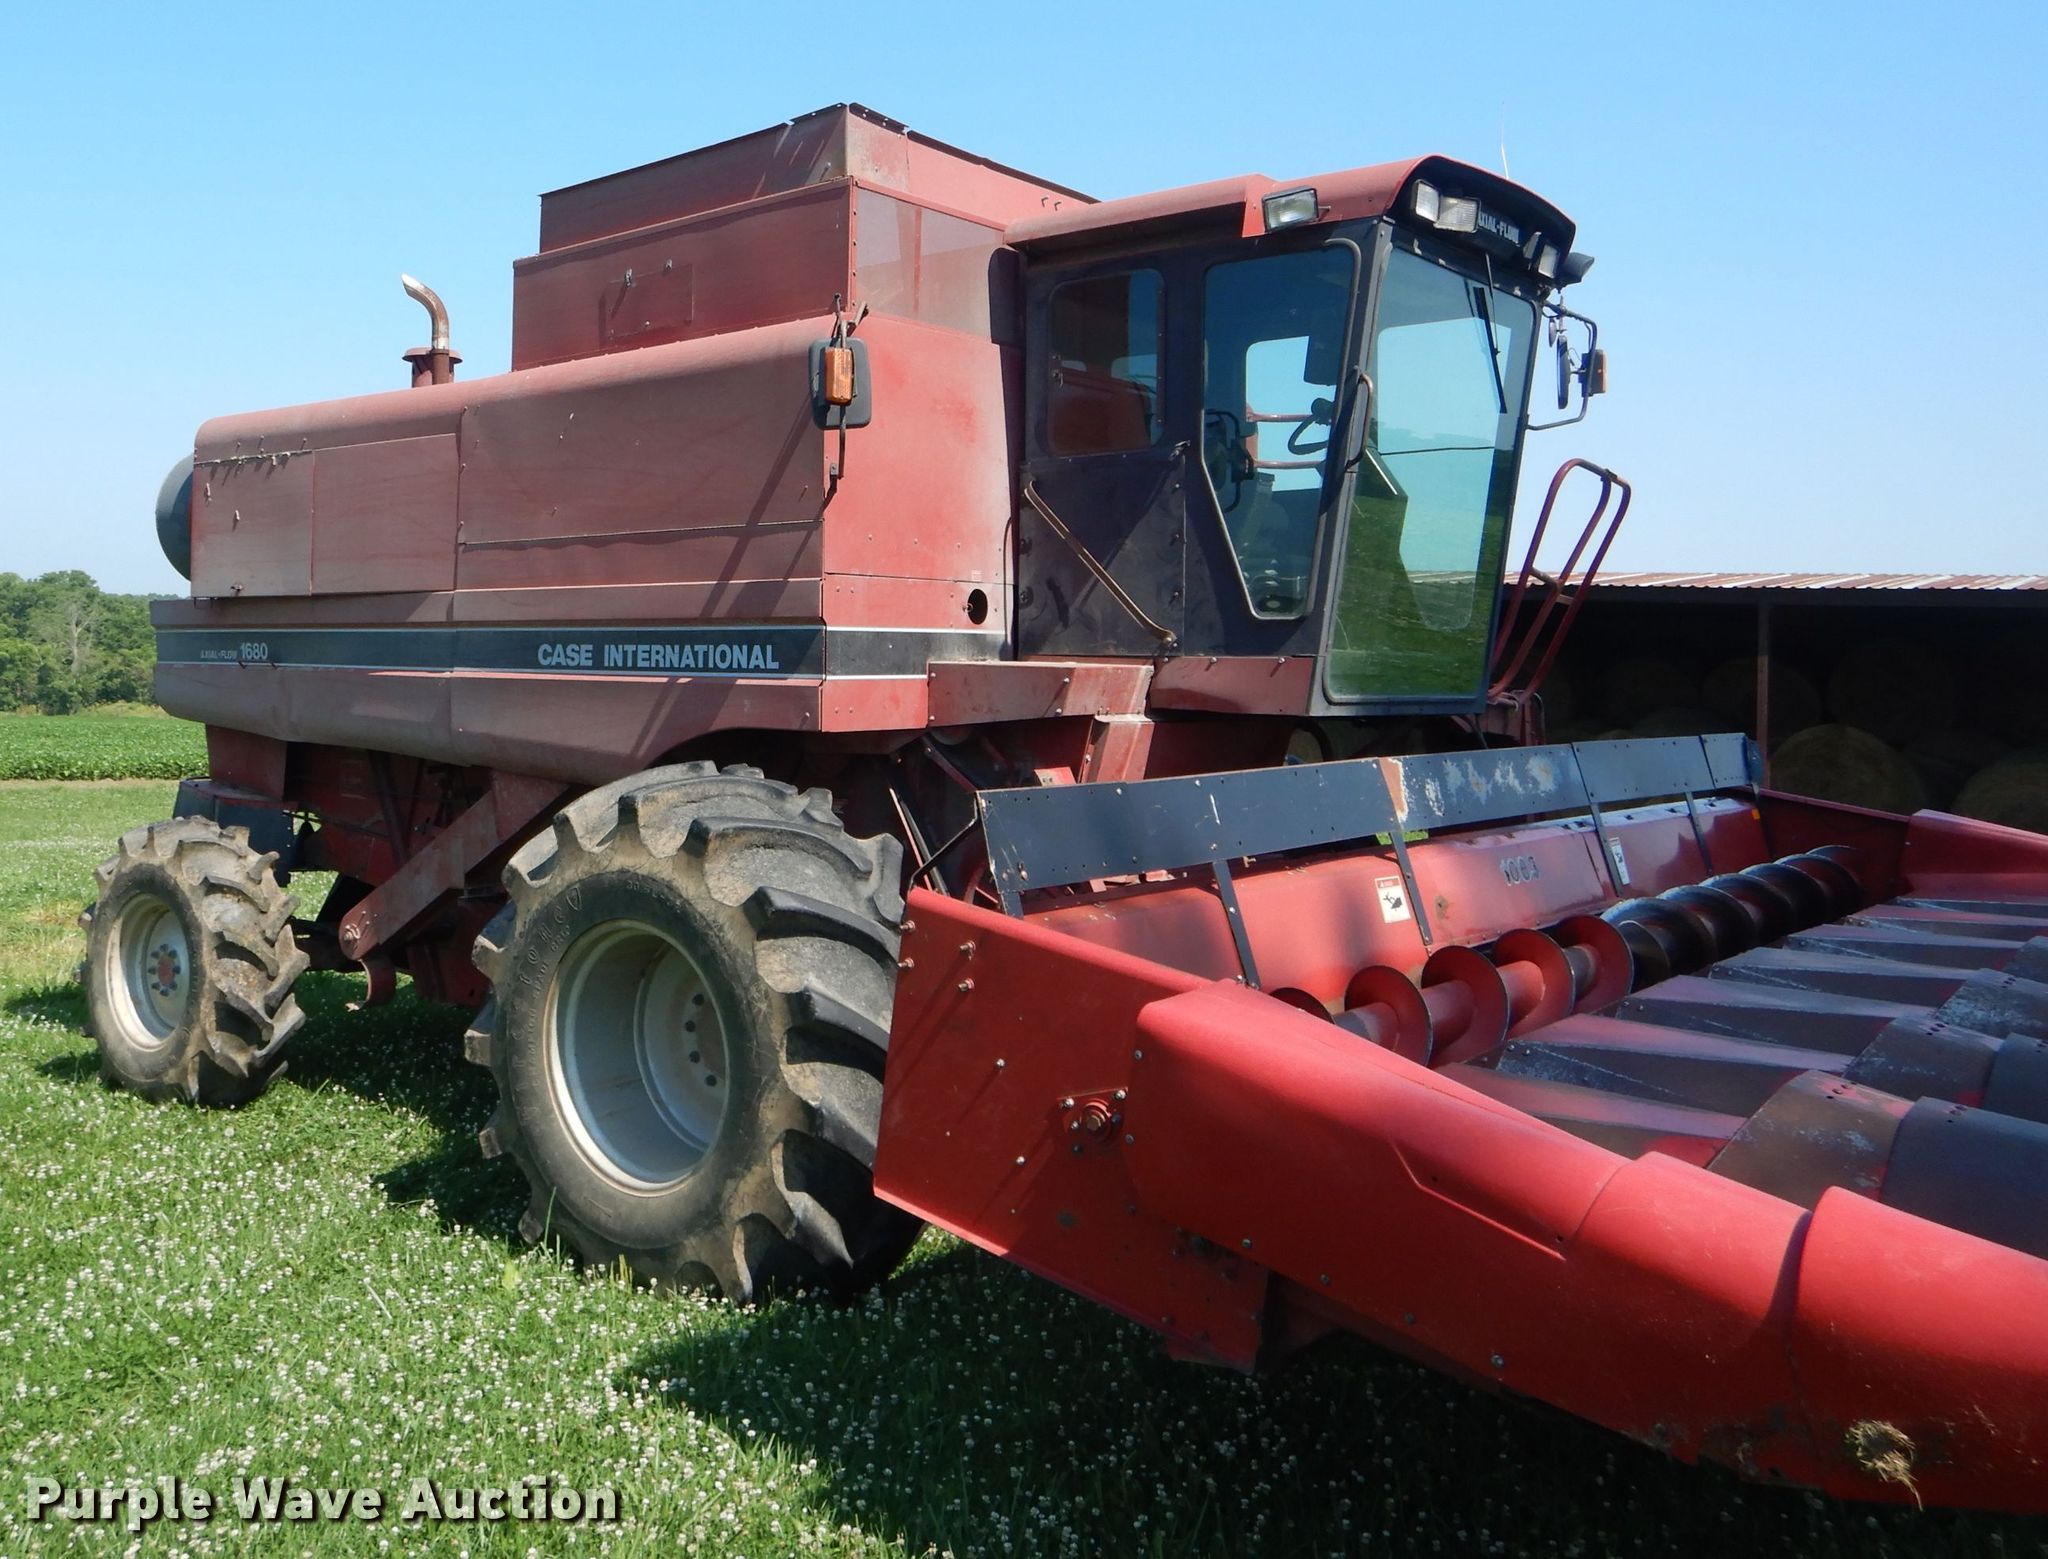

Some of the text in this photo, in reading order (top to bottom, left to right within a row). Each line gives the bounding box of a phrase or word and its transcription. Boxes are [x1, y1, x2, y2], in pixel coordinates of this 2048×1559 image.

[240, 642, 269, 661] 1680
[538, 643, 779, 669] CASE INTERNATIONAL
